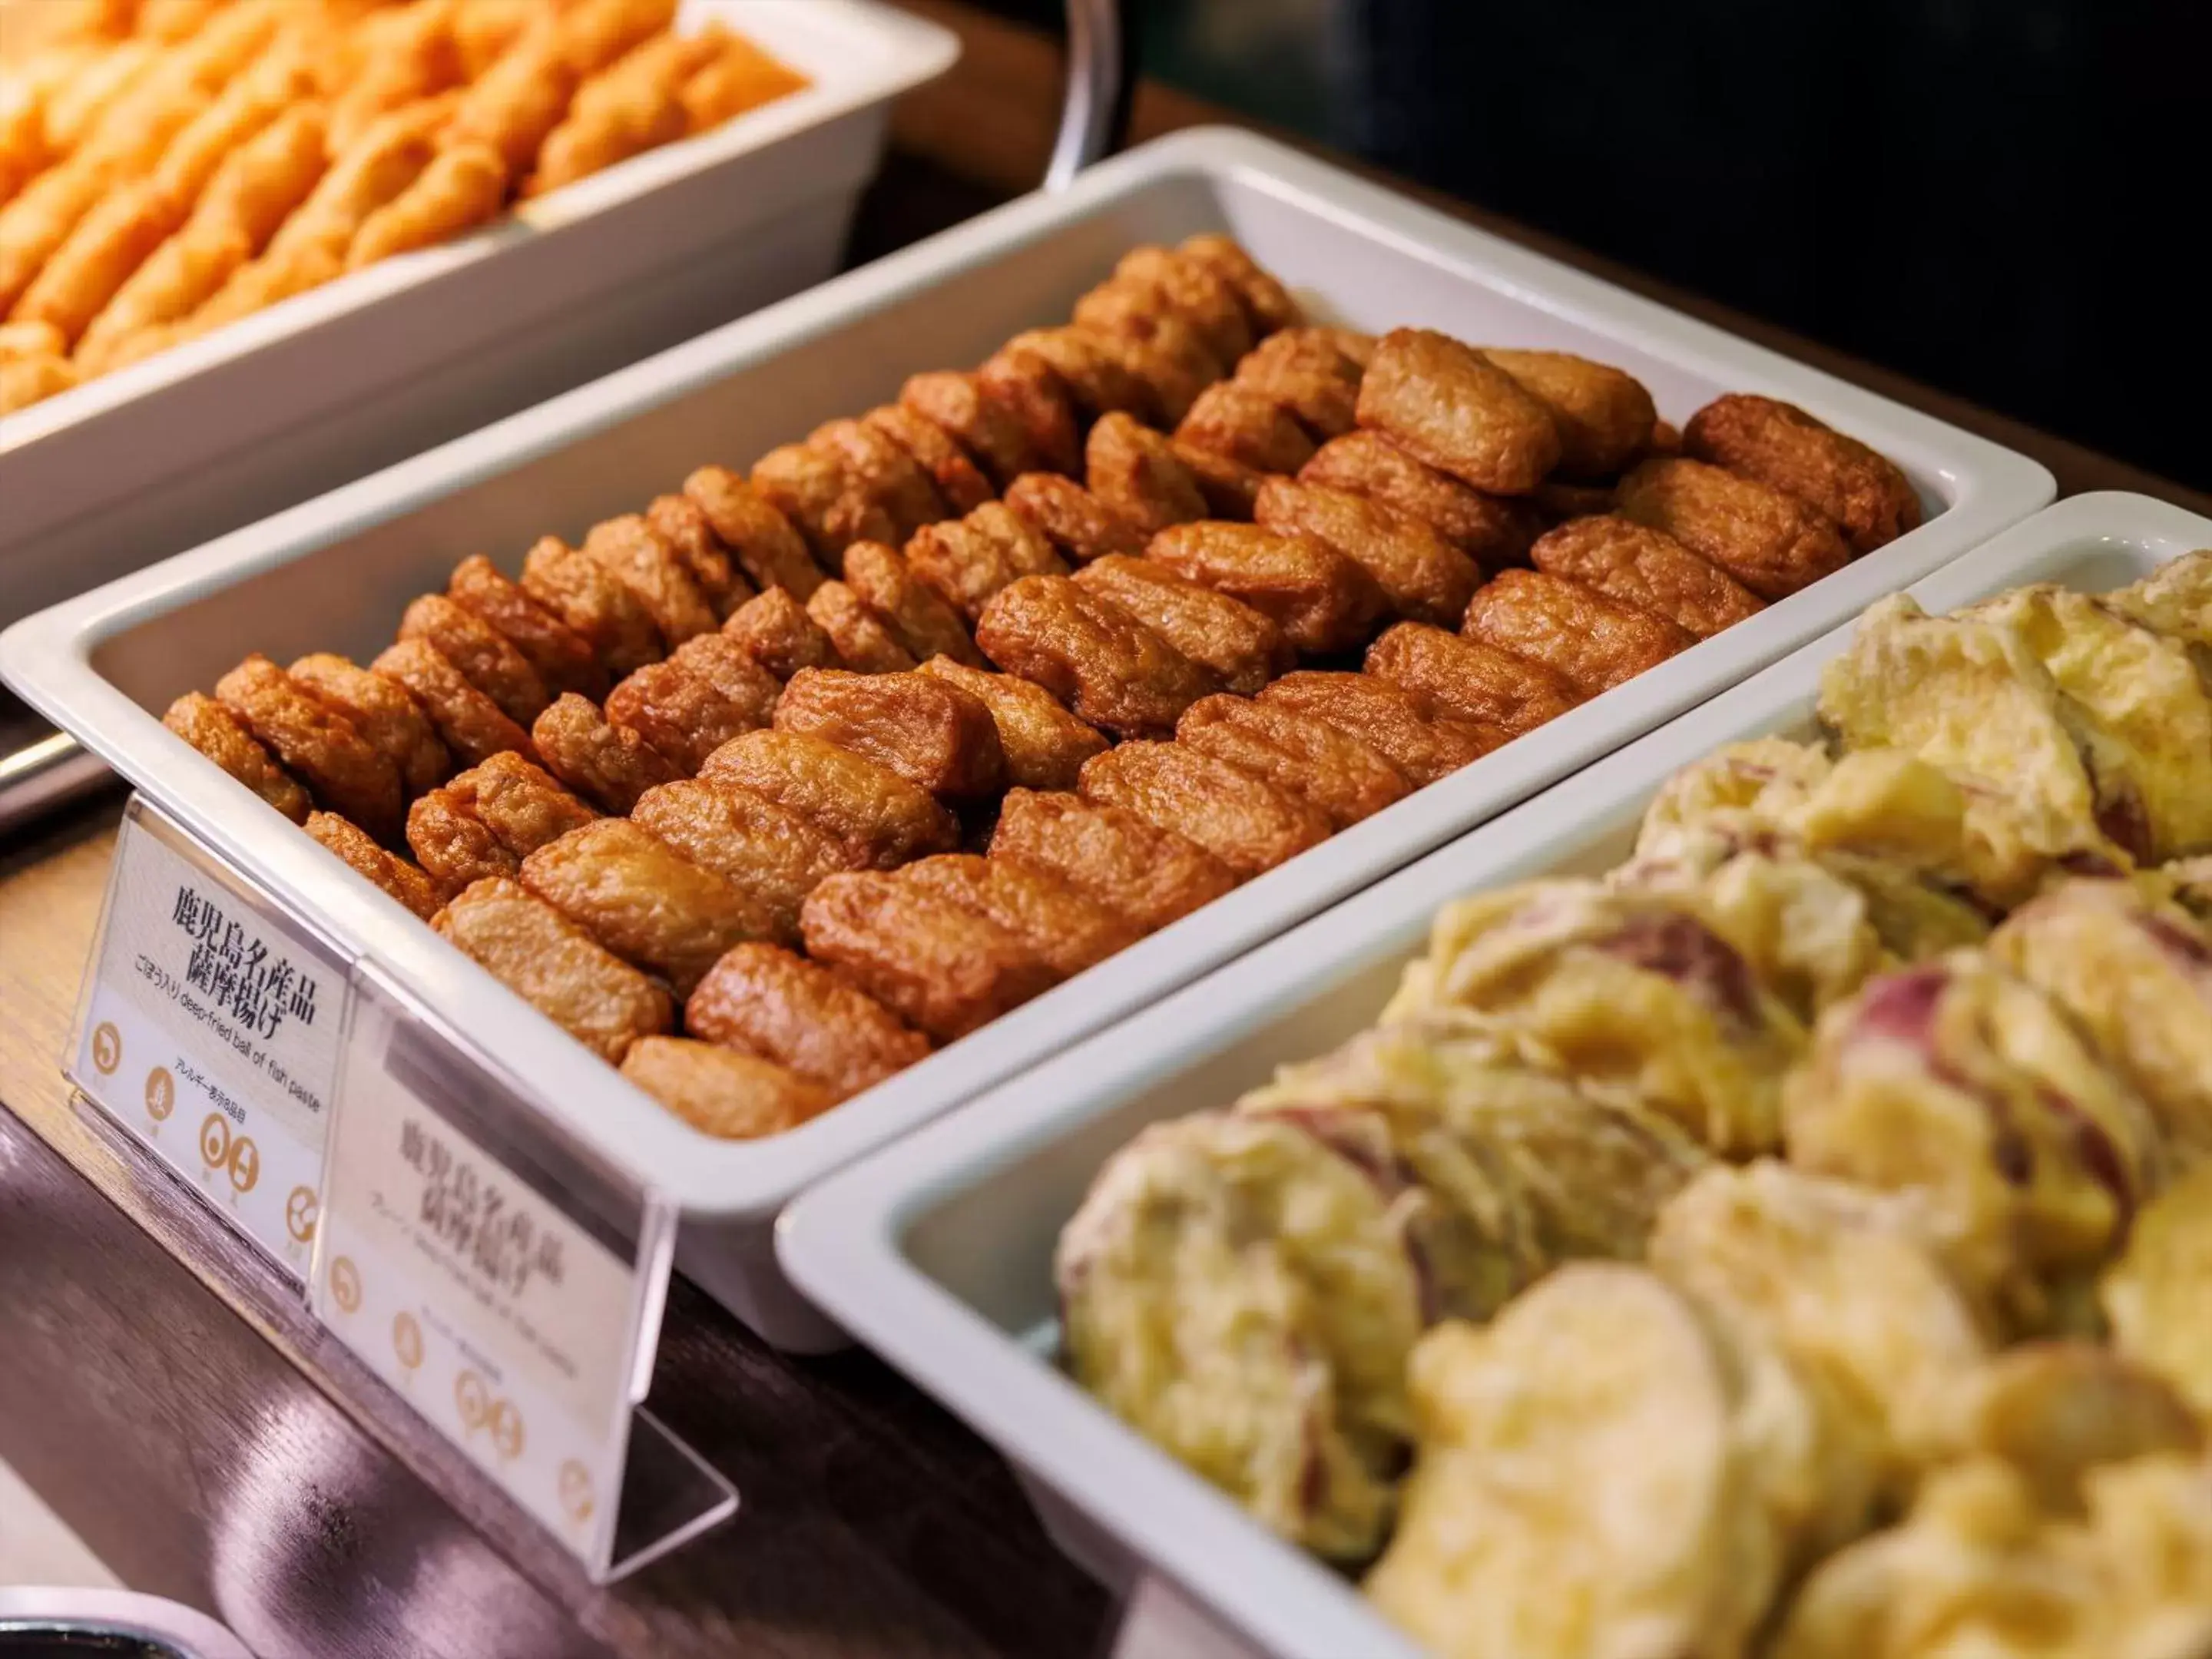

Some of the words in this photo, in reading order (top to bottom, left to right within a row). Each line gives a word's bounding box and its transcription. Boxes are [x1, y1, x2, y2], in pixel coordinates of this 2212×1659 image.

[172, 885, 316, 1025] 鹿児島名産品
[186, 942, 289, 1041] 薩摩揚げ
[231, 1030, 253, 1058] ball
[253, 1050, 267, 1068] of
[268, 1060, 290, 1088] fish
[289, 1080, 321, 1113] paste
